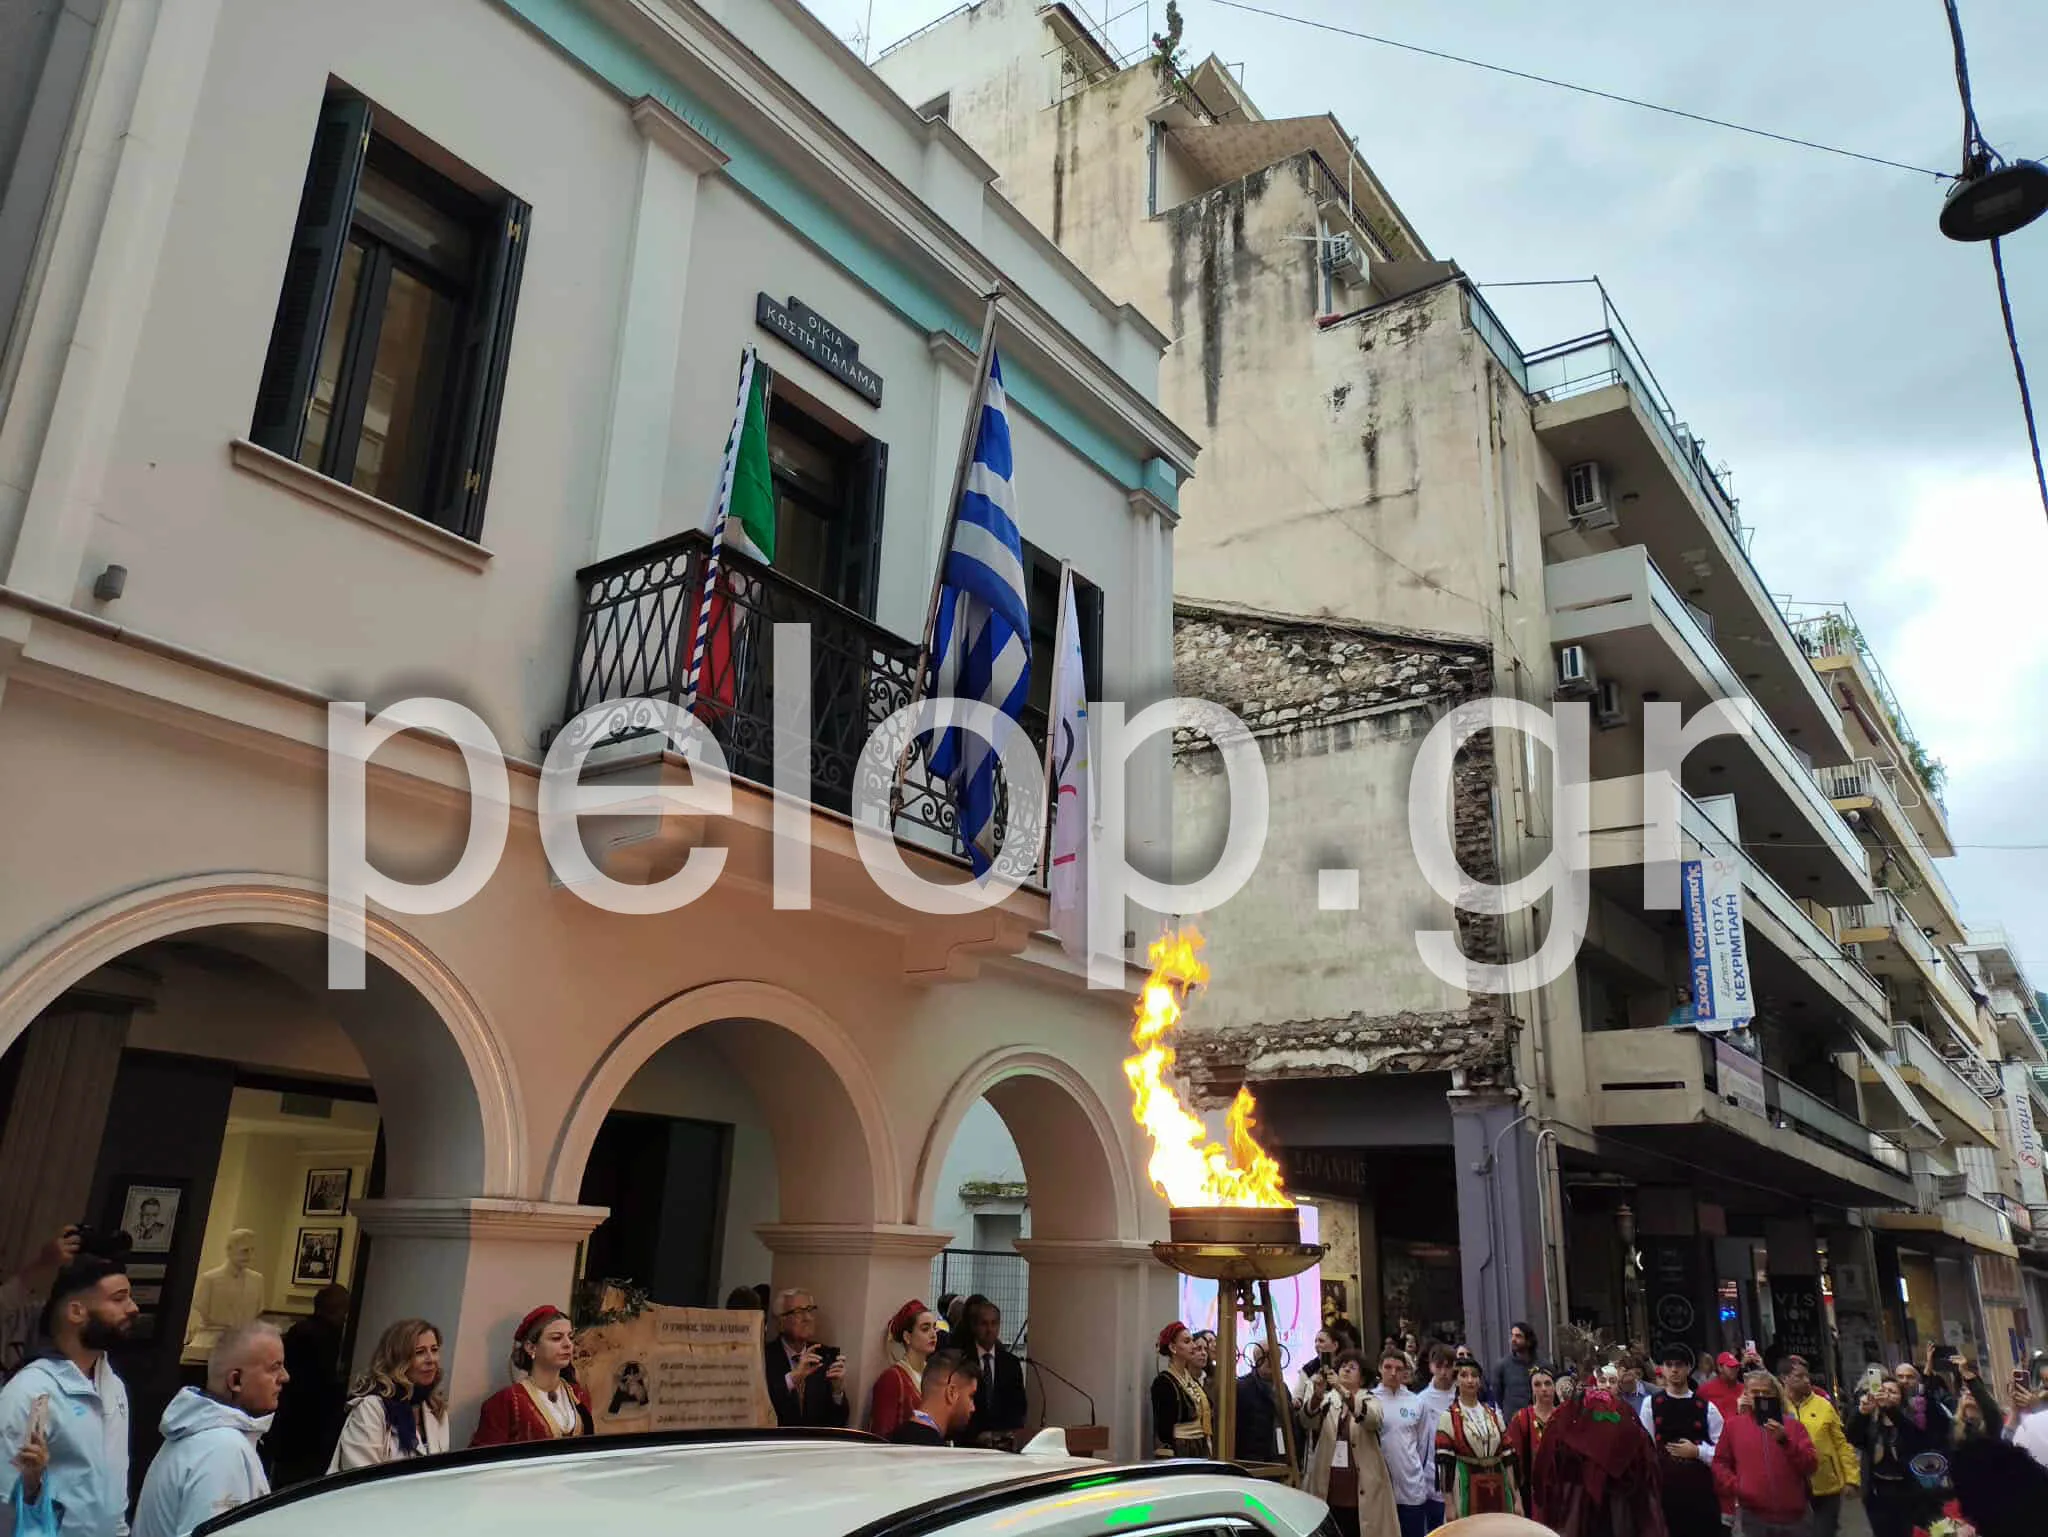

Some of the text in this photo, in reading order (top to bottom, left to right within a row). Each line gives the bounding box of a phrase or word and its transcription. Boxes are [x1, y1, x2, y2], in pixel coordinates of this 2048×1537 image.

[766, 304, 877, 393] ΚΩΣΤΗ ΠΑΛΑΜΑ
[808, 315, 843, 348] ΟΙΚΙΑ
[1711, 895, 1727, 946] ΓΙΩΤΑ
[1725, 893, 1747, 1002] ΚΕΧΡΙΜΠΑΡΗ
[1694, 964, 1712, 1017] Σχολή
